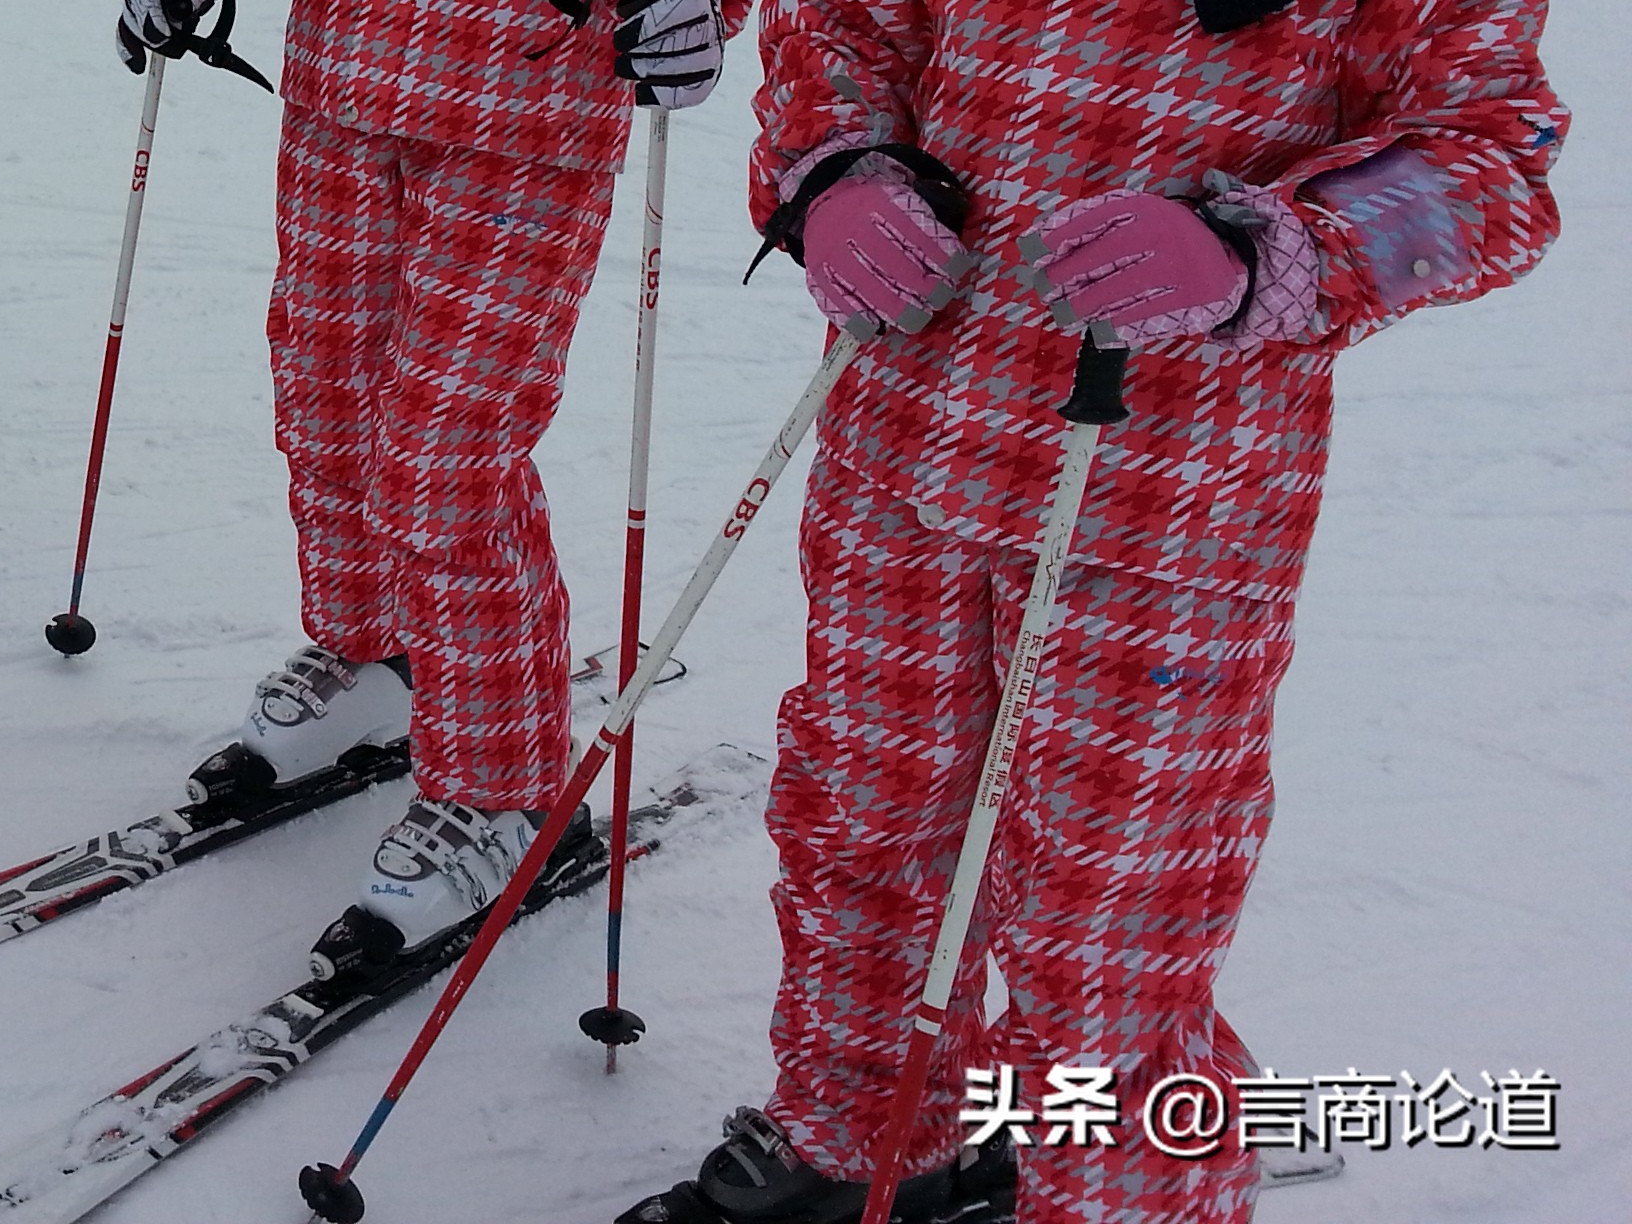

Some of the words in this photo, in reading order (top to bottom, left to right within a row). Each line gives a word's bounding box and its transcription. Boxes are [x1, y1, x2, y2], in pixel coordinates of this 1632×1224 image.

[132, 150, 150, 192] CBS
[645, 247, 661, 310] CBS
[724, 478, 770, 541] CBS
[1004, 630, 1031, 705] Changbaishan
[988, 633, 1044, 809] 长白山国际度假区
[989, 704, 1013, 772] International
[979, 773, 994, 808] Resort
